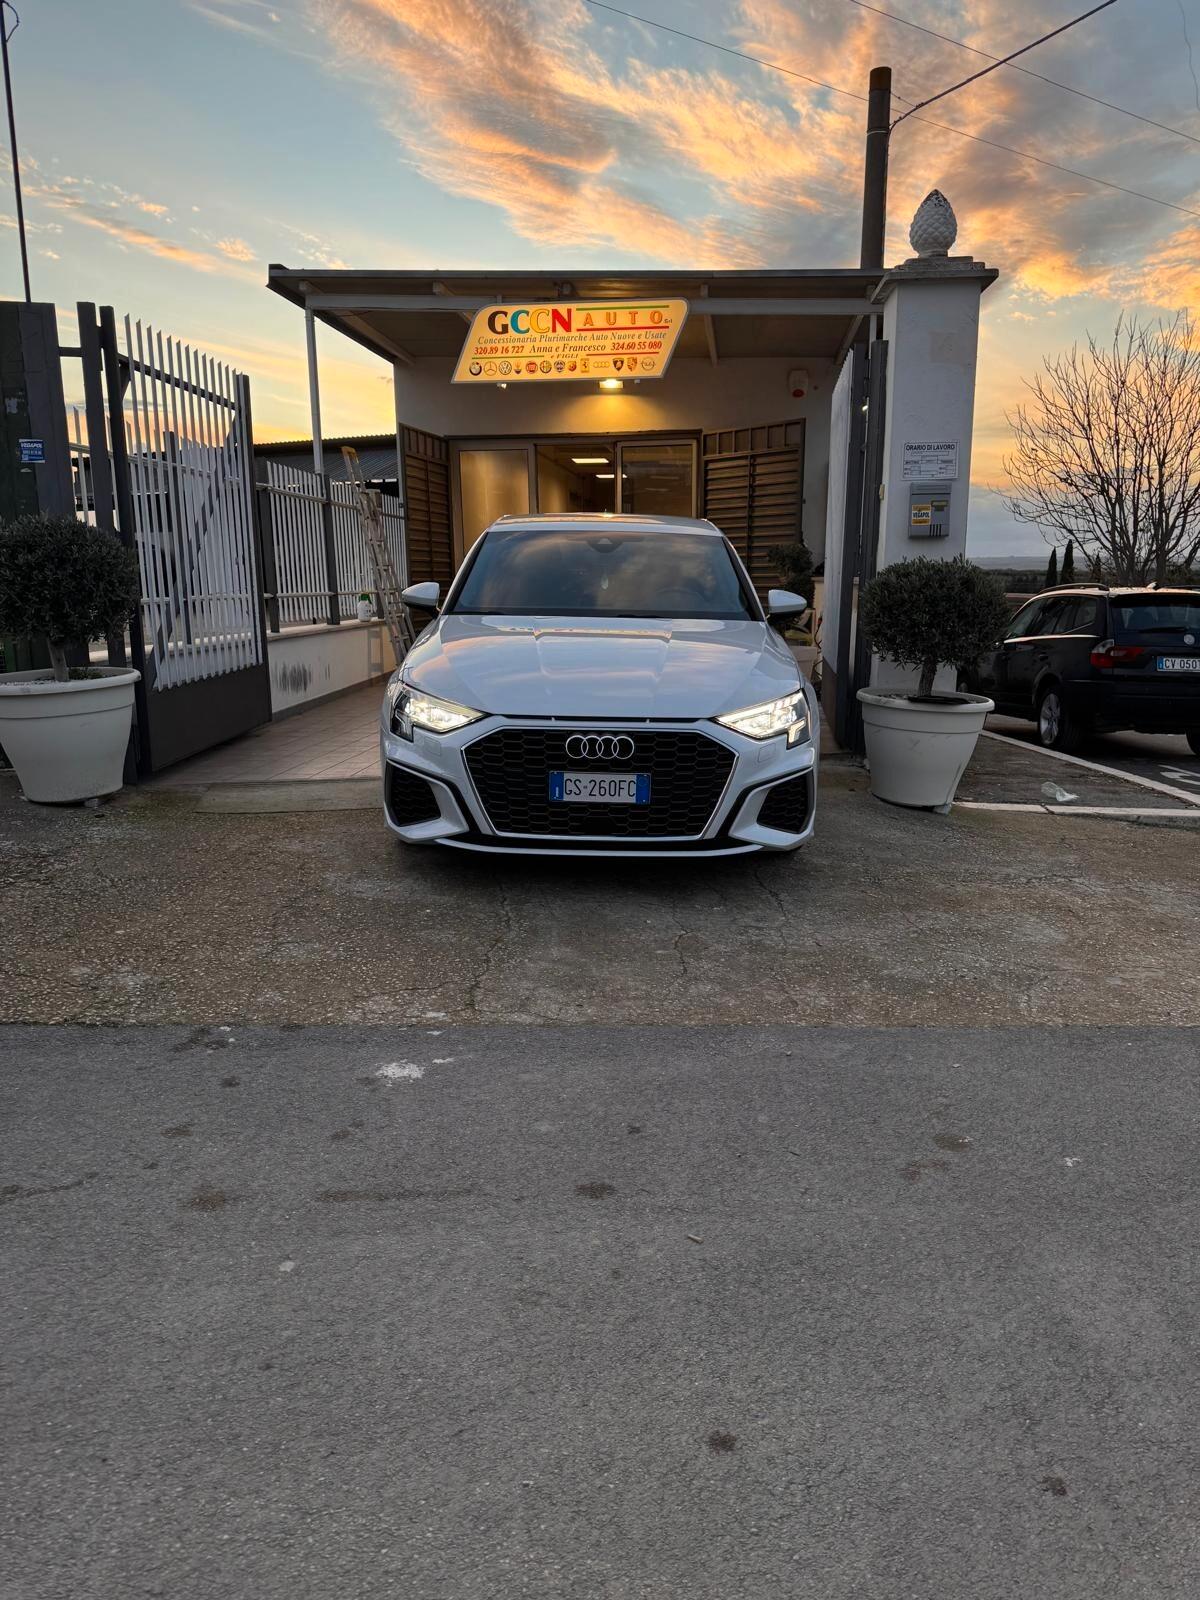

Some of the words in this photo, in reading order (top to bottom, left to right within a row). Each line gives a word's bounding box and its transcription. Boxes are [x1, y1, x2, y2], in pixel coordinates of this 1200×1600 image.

[487, 308, 573, 335] GCCN
[583, 310, 663, 327] AUTO
[478, 334, 537, 345] Concessionaria
[538, 332, 587, 343] Plurimarche
[590, 332, 608, 341] Auto
[610, 331, 635, 341] Nuove
[644, 331, 667, 340] Usate
[474, 346, 499, 355] 320.89
[500, 346, 510, 354] 16
[511, 345, 525, 354] 727
[529, 344, 553, 353] Anna
[562, 342, 606, 353] Francesco
[611, 341, 636, 351] 324.60
[637, 341, 647, 350] 55
[648, 340, 662, 350] 080
[1165, 659, 1176, 669] CV
[1180, 660, 1200, 669] 050
